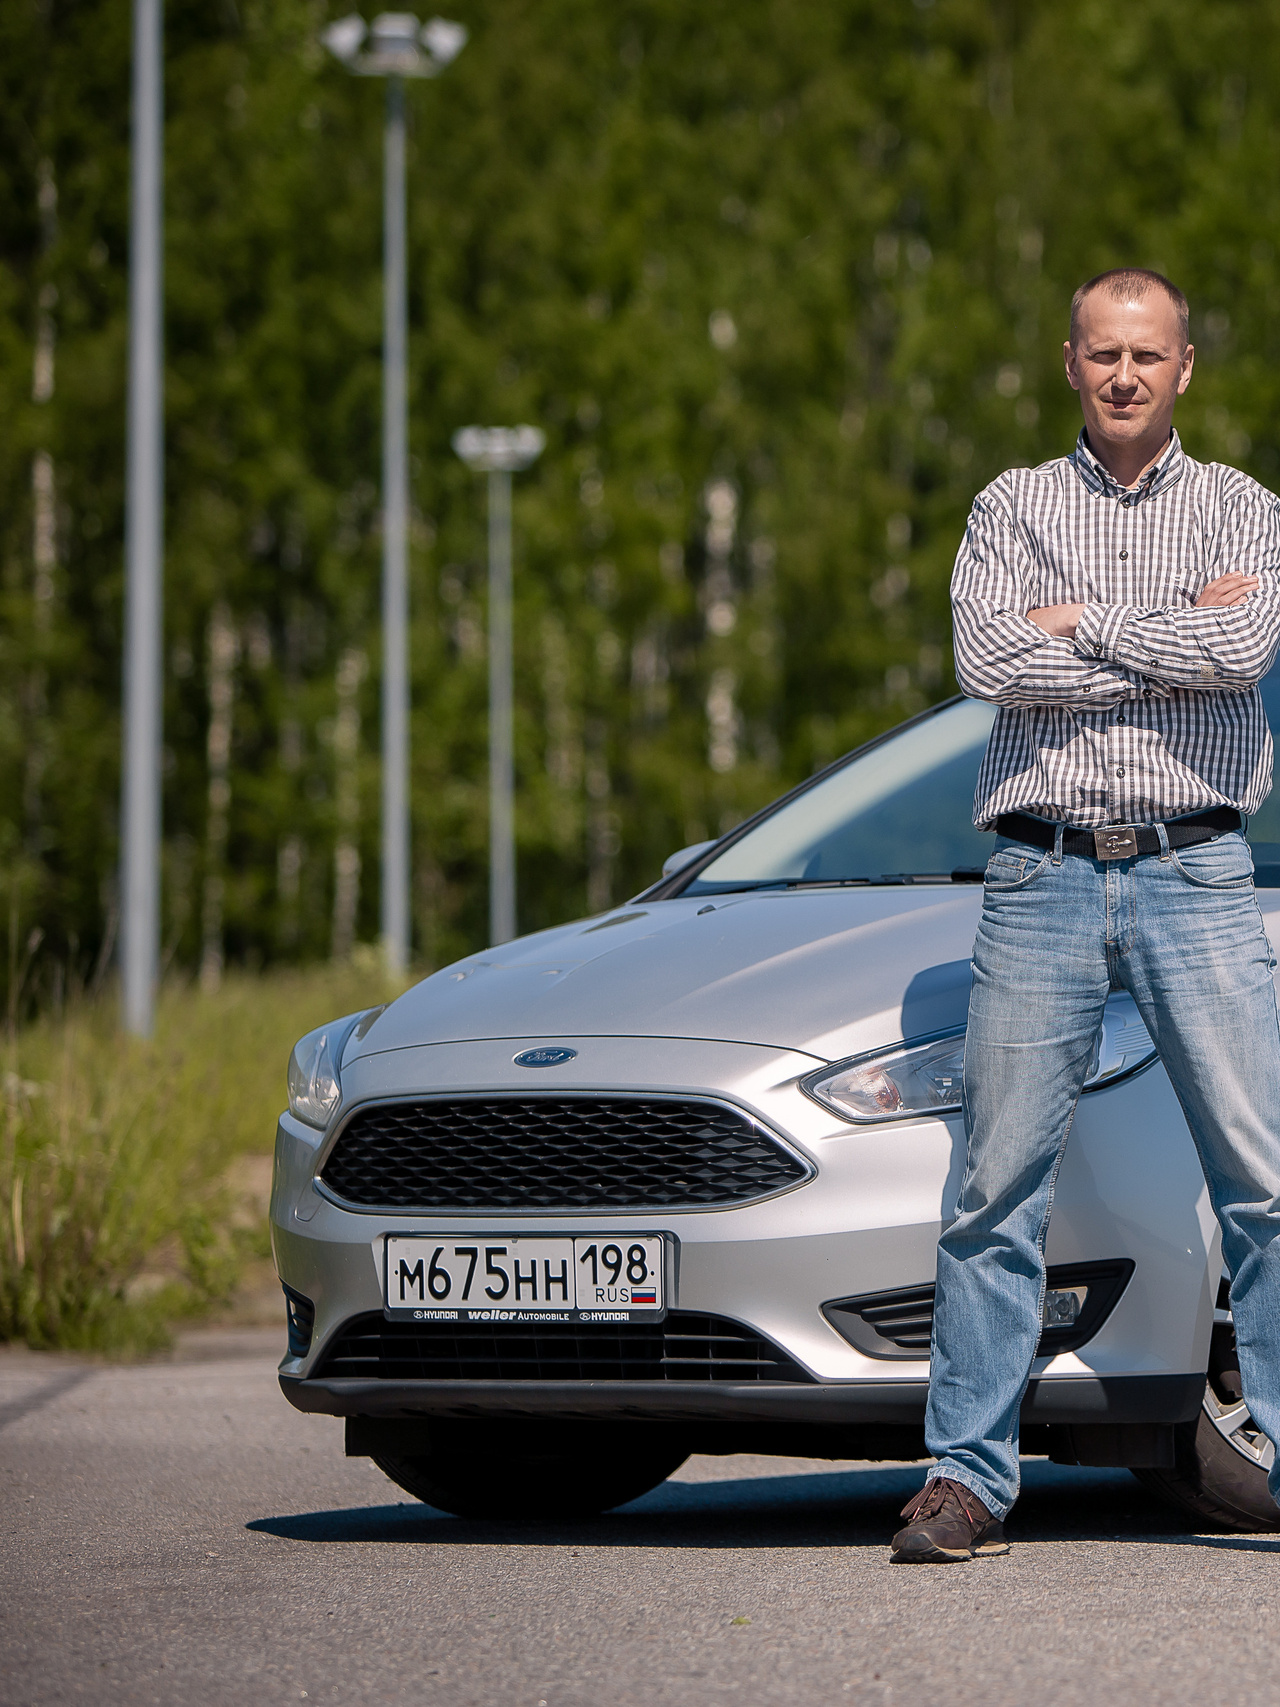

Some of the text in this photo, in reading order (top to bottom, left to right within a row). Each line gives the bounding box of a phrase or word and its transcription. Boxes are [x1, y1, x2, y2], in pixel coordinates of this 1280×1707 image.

[579, 1243, 648, 1286] 198
[595, 1287, 629, 1303] RUS
[423, 1311, 458, 1320] HYUNDAI
[468, 1309, 516, 1321] weller
[591, 1312, 630, 1321] HYUNDAI
